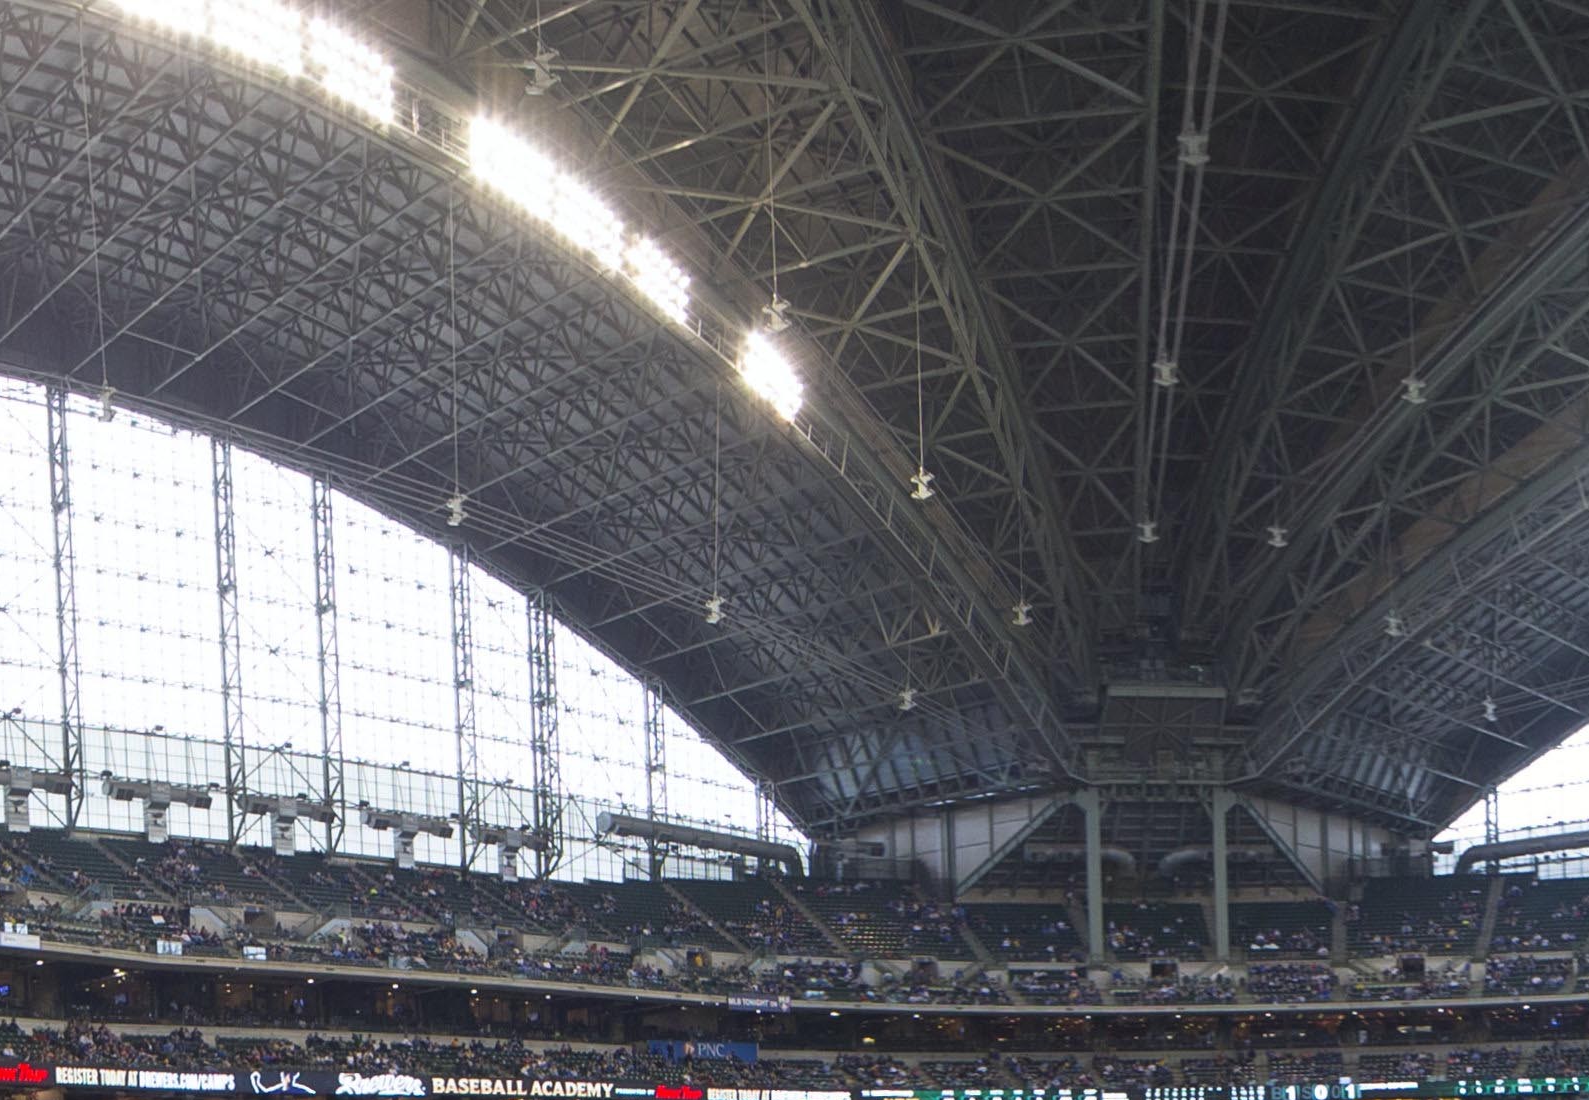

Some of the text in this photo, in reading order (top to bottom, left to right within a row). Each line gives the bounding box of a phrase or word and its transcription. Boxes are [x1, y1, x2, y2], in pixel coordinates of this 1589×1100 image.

[698, 1043, 725, 1058] PNC
[56, 1067, 98, 1085] REGISTER
[100, 1068, 127, 1087] TODAY
[431, 1077, 527, 1096] BASEBALL
[530, 1080, 614, 1098] ACADEMY
